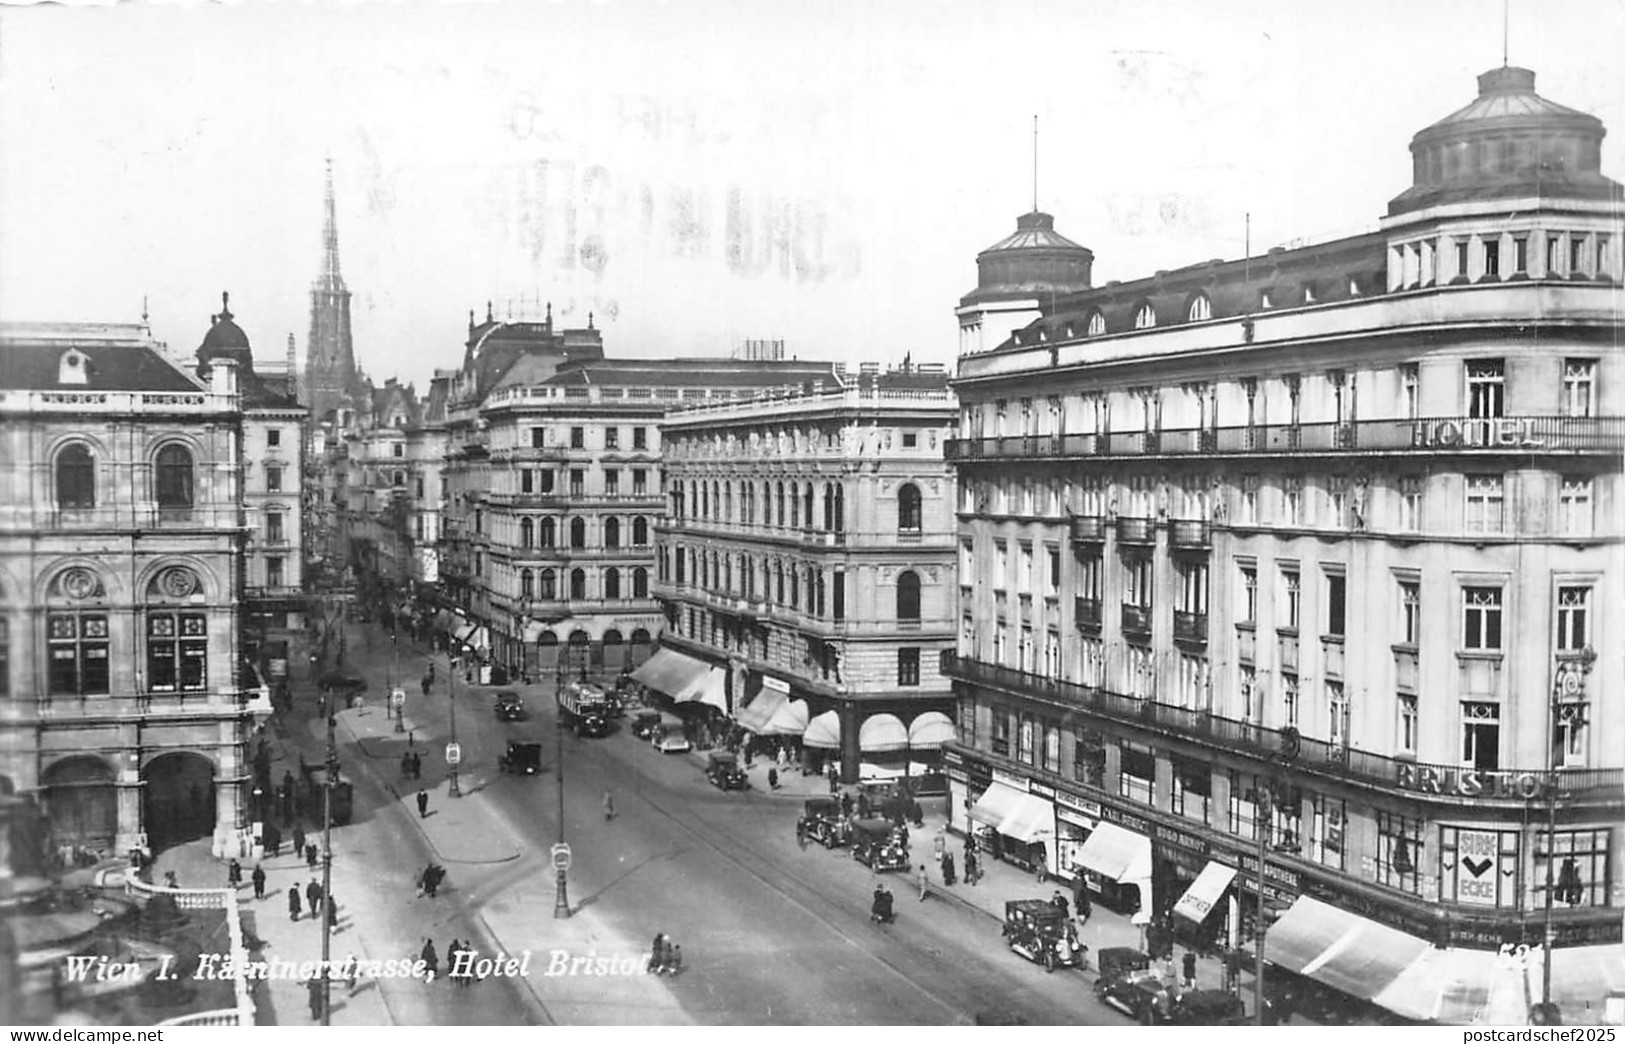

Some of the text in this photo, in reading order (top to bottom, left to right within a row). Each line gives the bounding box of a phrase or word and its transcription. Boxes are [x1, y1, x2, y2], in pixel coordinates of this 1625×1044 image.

[1412, 418, 1545, 447] HOTEL
[1460, 832, 1496, 857] SIRK
[1460, 879, 1493, 899] ECKE
